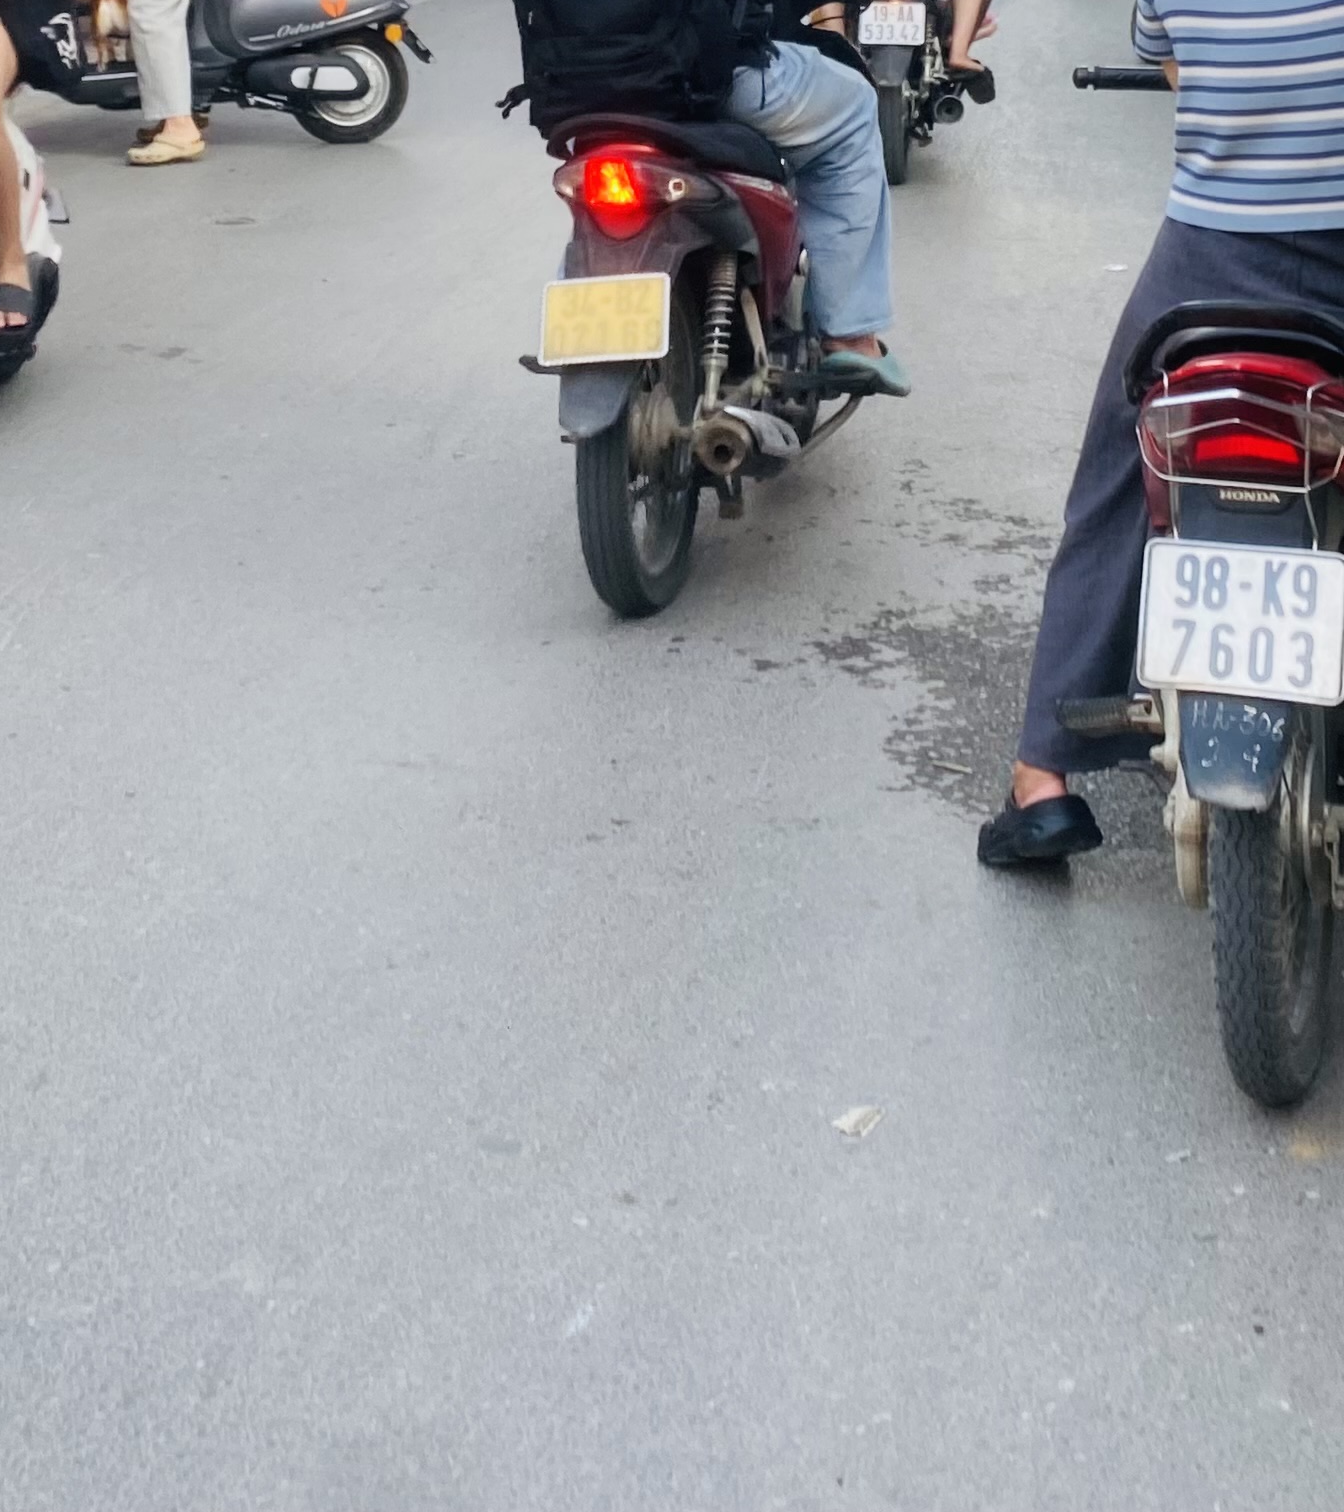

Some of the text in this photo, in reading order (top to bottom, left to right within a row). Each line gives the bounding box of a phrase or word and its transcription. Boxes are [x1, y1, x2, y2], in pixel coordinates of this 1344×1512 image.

[1218, 488, 1281, 504] HONDA
[1174, 553, 1319, 619] 98-K9
[1169, 618, 1316, 689] 7603
